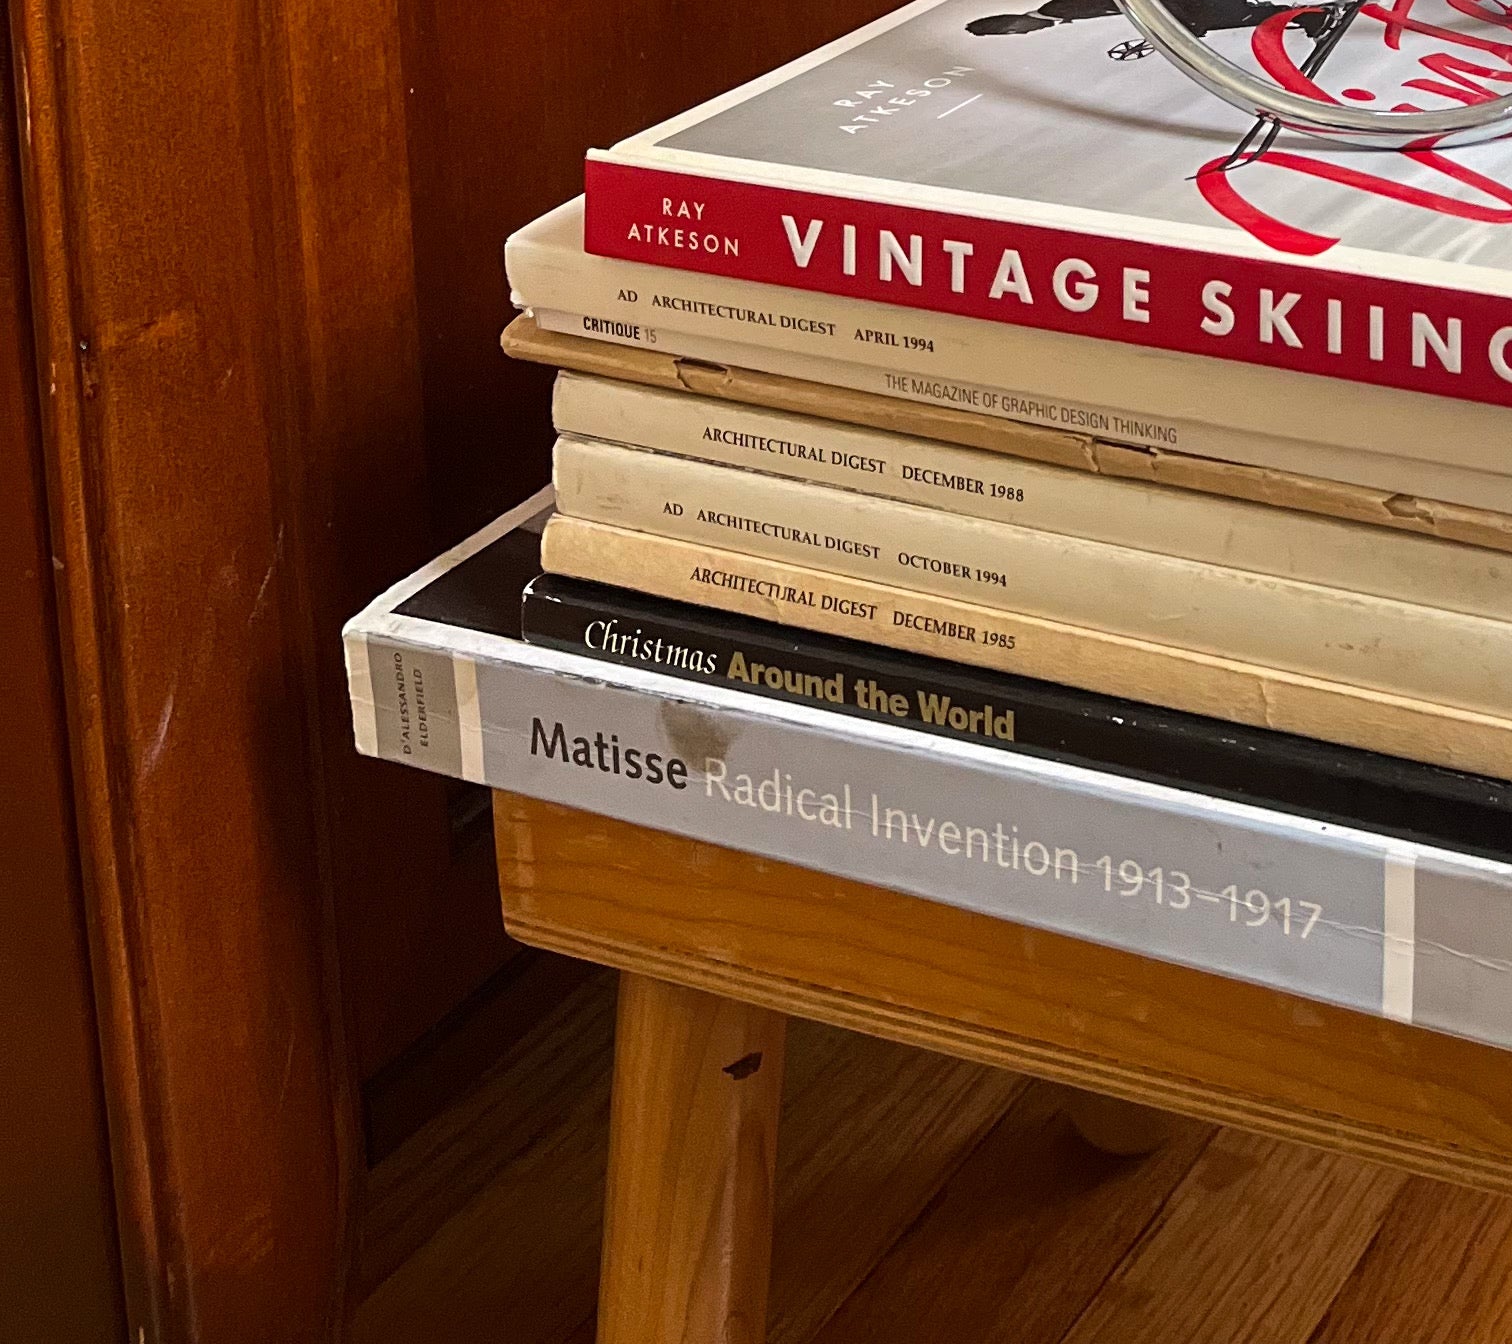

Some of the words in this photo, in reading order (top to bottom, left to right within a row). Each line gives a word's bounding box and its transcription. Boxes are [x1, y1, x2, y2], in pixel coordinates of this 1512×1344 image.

[832, 80, 895, 108] RAY
[838, 65, 975, 135] ATKESON
[627, 222, 740, 257] ATKESON
[662, 197, 706, 221] RAY
[780, 214, 1151, 324] VINTAGE
[583, 315, 641, 341] CRITIQUE
[644, 327, 657, 344] 15
[617, 288, 639, 303] AD
[651, 294, 777, 327] ARCHITECTURAL
[779, 315, 837, 336] DIGEST
[853, 327, 900, 347] APRIL
[903, 335, 935, 353] 1994
[884, 373, 909, 393] THE
[911, 378, 980, 407] MAGAZINE
[982, 391, 1000, 409] OF
[1001, 395, 1058, 422] GRAPHIC
[1060, 407, 1110, 432] DESIGN
[1113, 416, 1178, 445] THINKING
[702, 426, 827, 464] ARCHITECTURAL
[831, 451, 887, 474] DIGEST
[901, 465, 985, 495] DECEMBER
[989, 483, 1025, 503] 1988
[662, 501, 684, 517] AD
[696, 509, 821, 547] ARCHITECTURAL
[824, 535, 881, 560] DIGEST
[898, 551, 971, 580] OCTOBER
[975, 568, 1007, 588] 1994
[690, 566, 817, 607] ARCHITECTURAL
[820, 594, 878, 621] DIGEST
[892, 610, 976, 643] DECEMBER
[981, 630, 1017, 650] 1985
[393, 652, 412, 755] D'ALESSANDRO
[413, 668, 429, 748] ELDERFIELD
[584, 618, 717, 675] Christmas
[726, 650, 845, 704] Around
[854, 678, 909, 717] the
[916, 689, 1017, 742] World
[530, 716, 688, 790] Matisse
[705, 757, 852, 830] Radical
[870, 792, 1079, 885] Invention
[1096, 854, 1324, 940] 1913–1917
